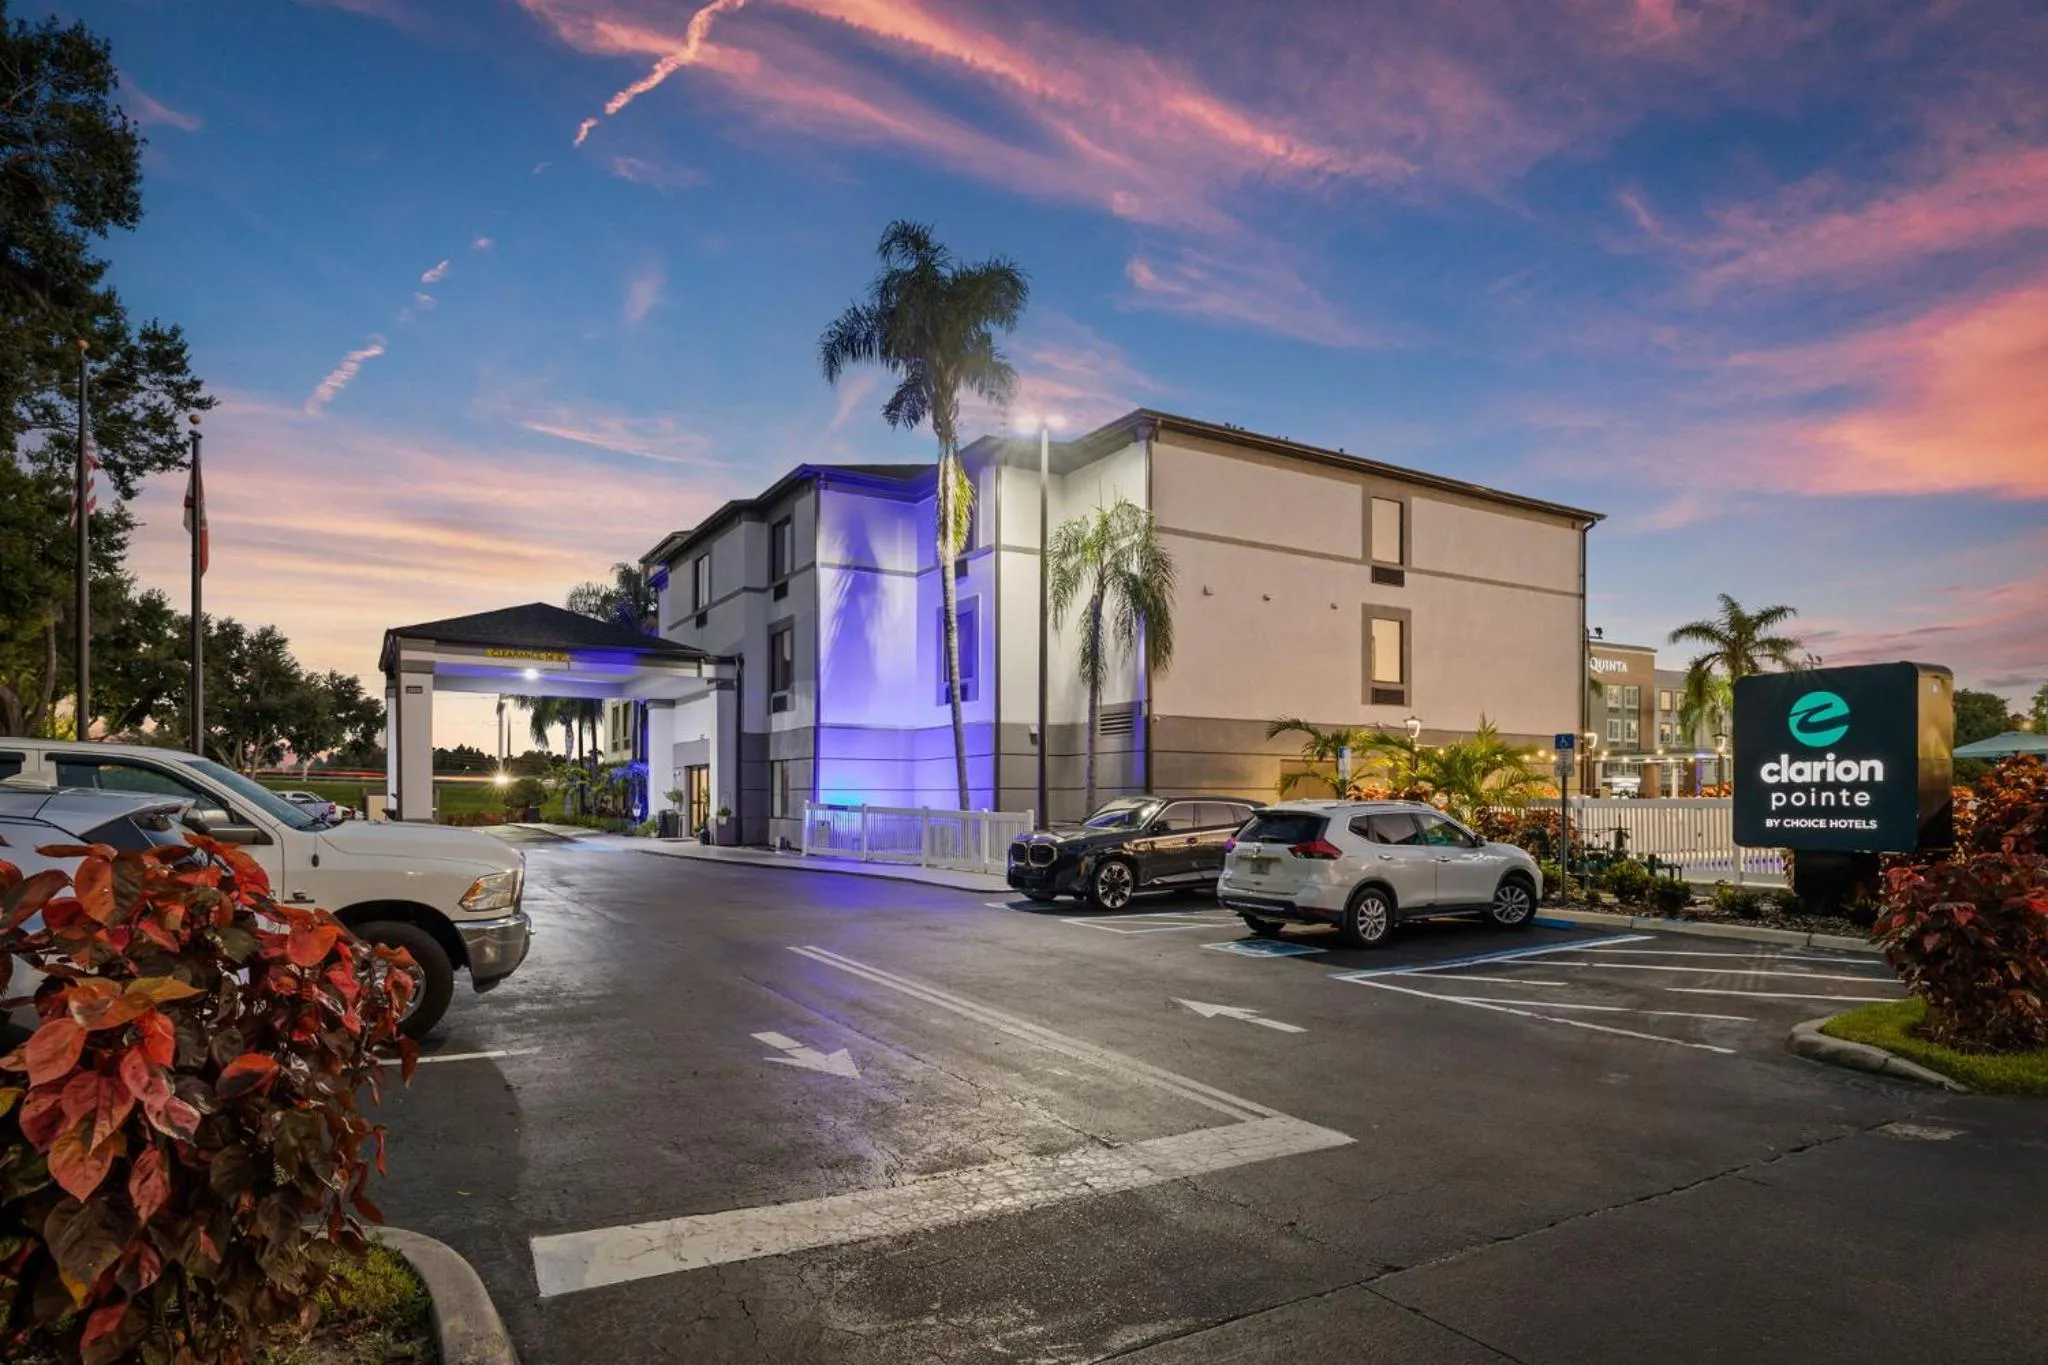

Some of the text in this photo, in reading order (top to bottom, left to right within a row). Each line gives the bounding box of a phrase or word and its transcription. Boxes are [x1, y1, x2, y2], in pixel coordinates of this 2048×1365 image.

[1590, 656, 1628, 673] QUINTA
[1760, 752, 1884, 784] clarion
[1771, 787, 1871, 811] pointe
[1765, 818, 1878, 830] BY CHOICE HOTELS
